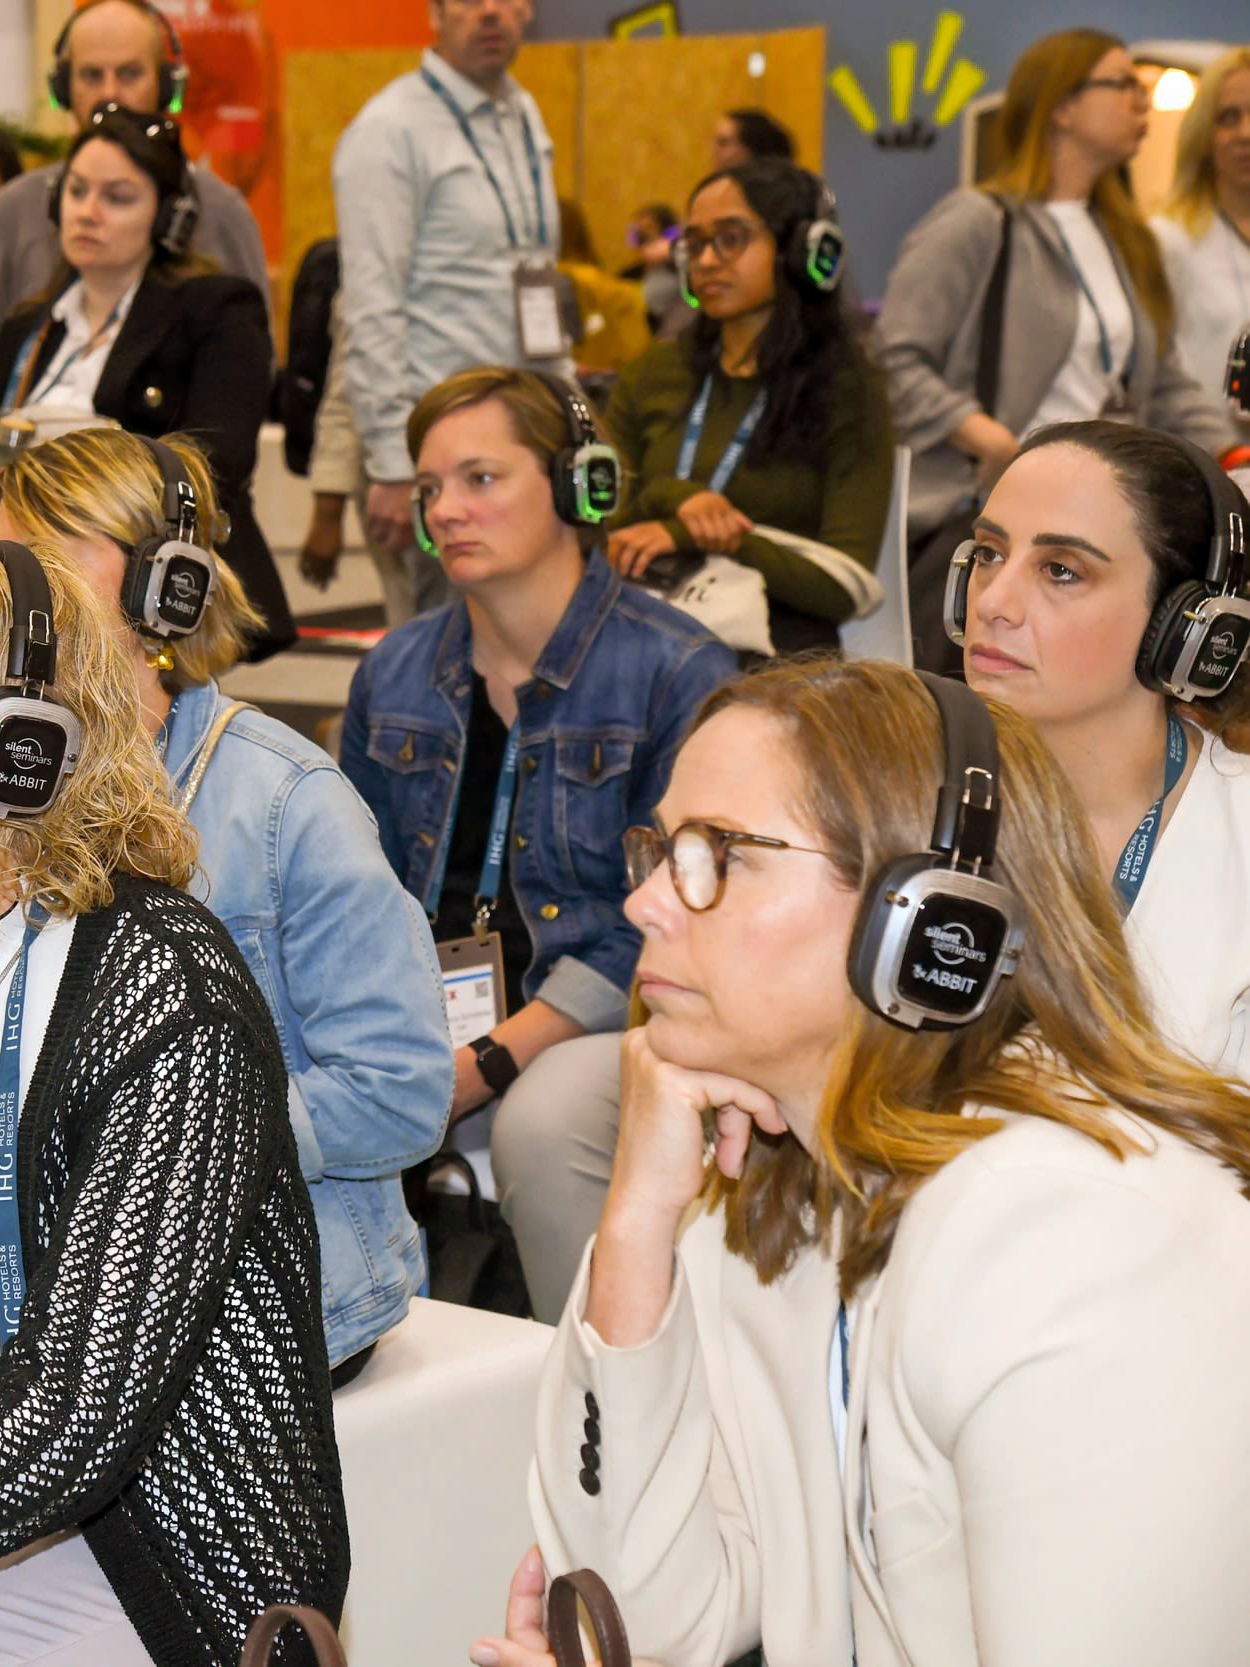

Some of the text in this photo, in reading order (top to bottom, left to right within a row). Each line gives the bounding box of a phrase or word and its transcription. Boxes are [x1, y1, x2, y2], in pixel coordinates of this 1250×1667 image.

[5, 741, 32, 754] silent
[10, 752, 53, 766] seminars
[8, 774, 48, 791] ABBIT
[489, 832, 505, 865] IHG
[1119, 834, 1140, 880] RESORTS
[1132, 834, 1149, 875] HOTELS
[924, 926, 961, 944] silent
[931, 940, 987, 962] seminars
[925, 968, 978, 994] ABBIT
[6, 1003, 20, 1050] IHG
[0, 1092, 7, 1100] &
[6, 1091, 15, 1147] RESORTS
[9, 1244, 22, 1300] RESORTS
